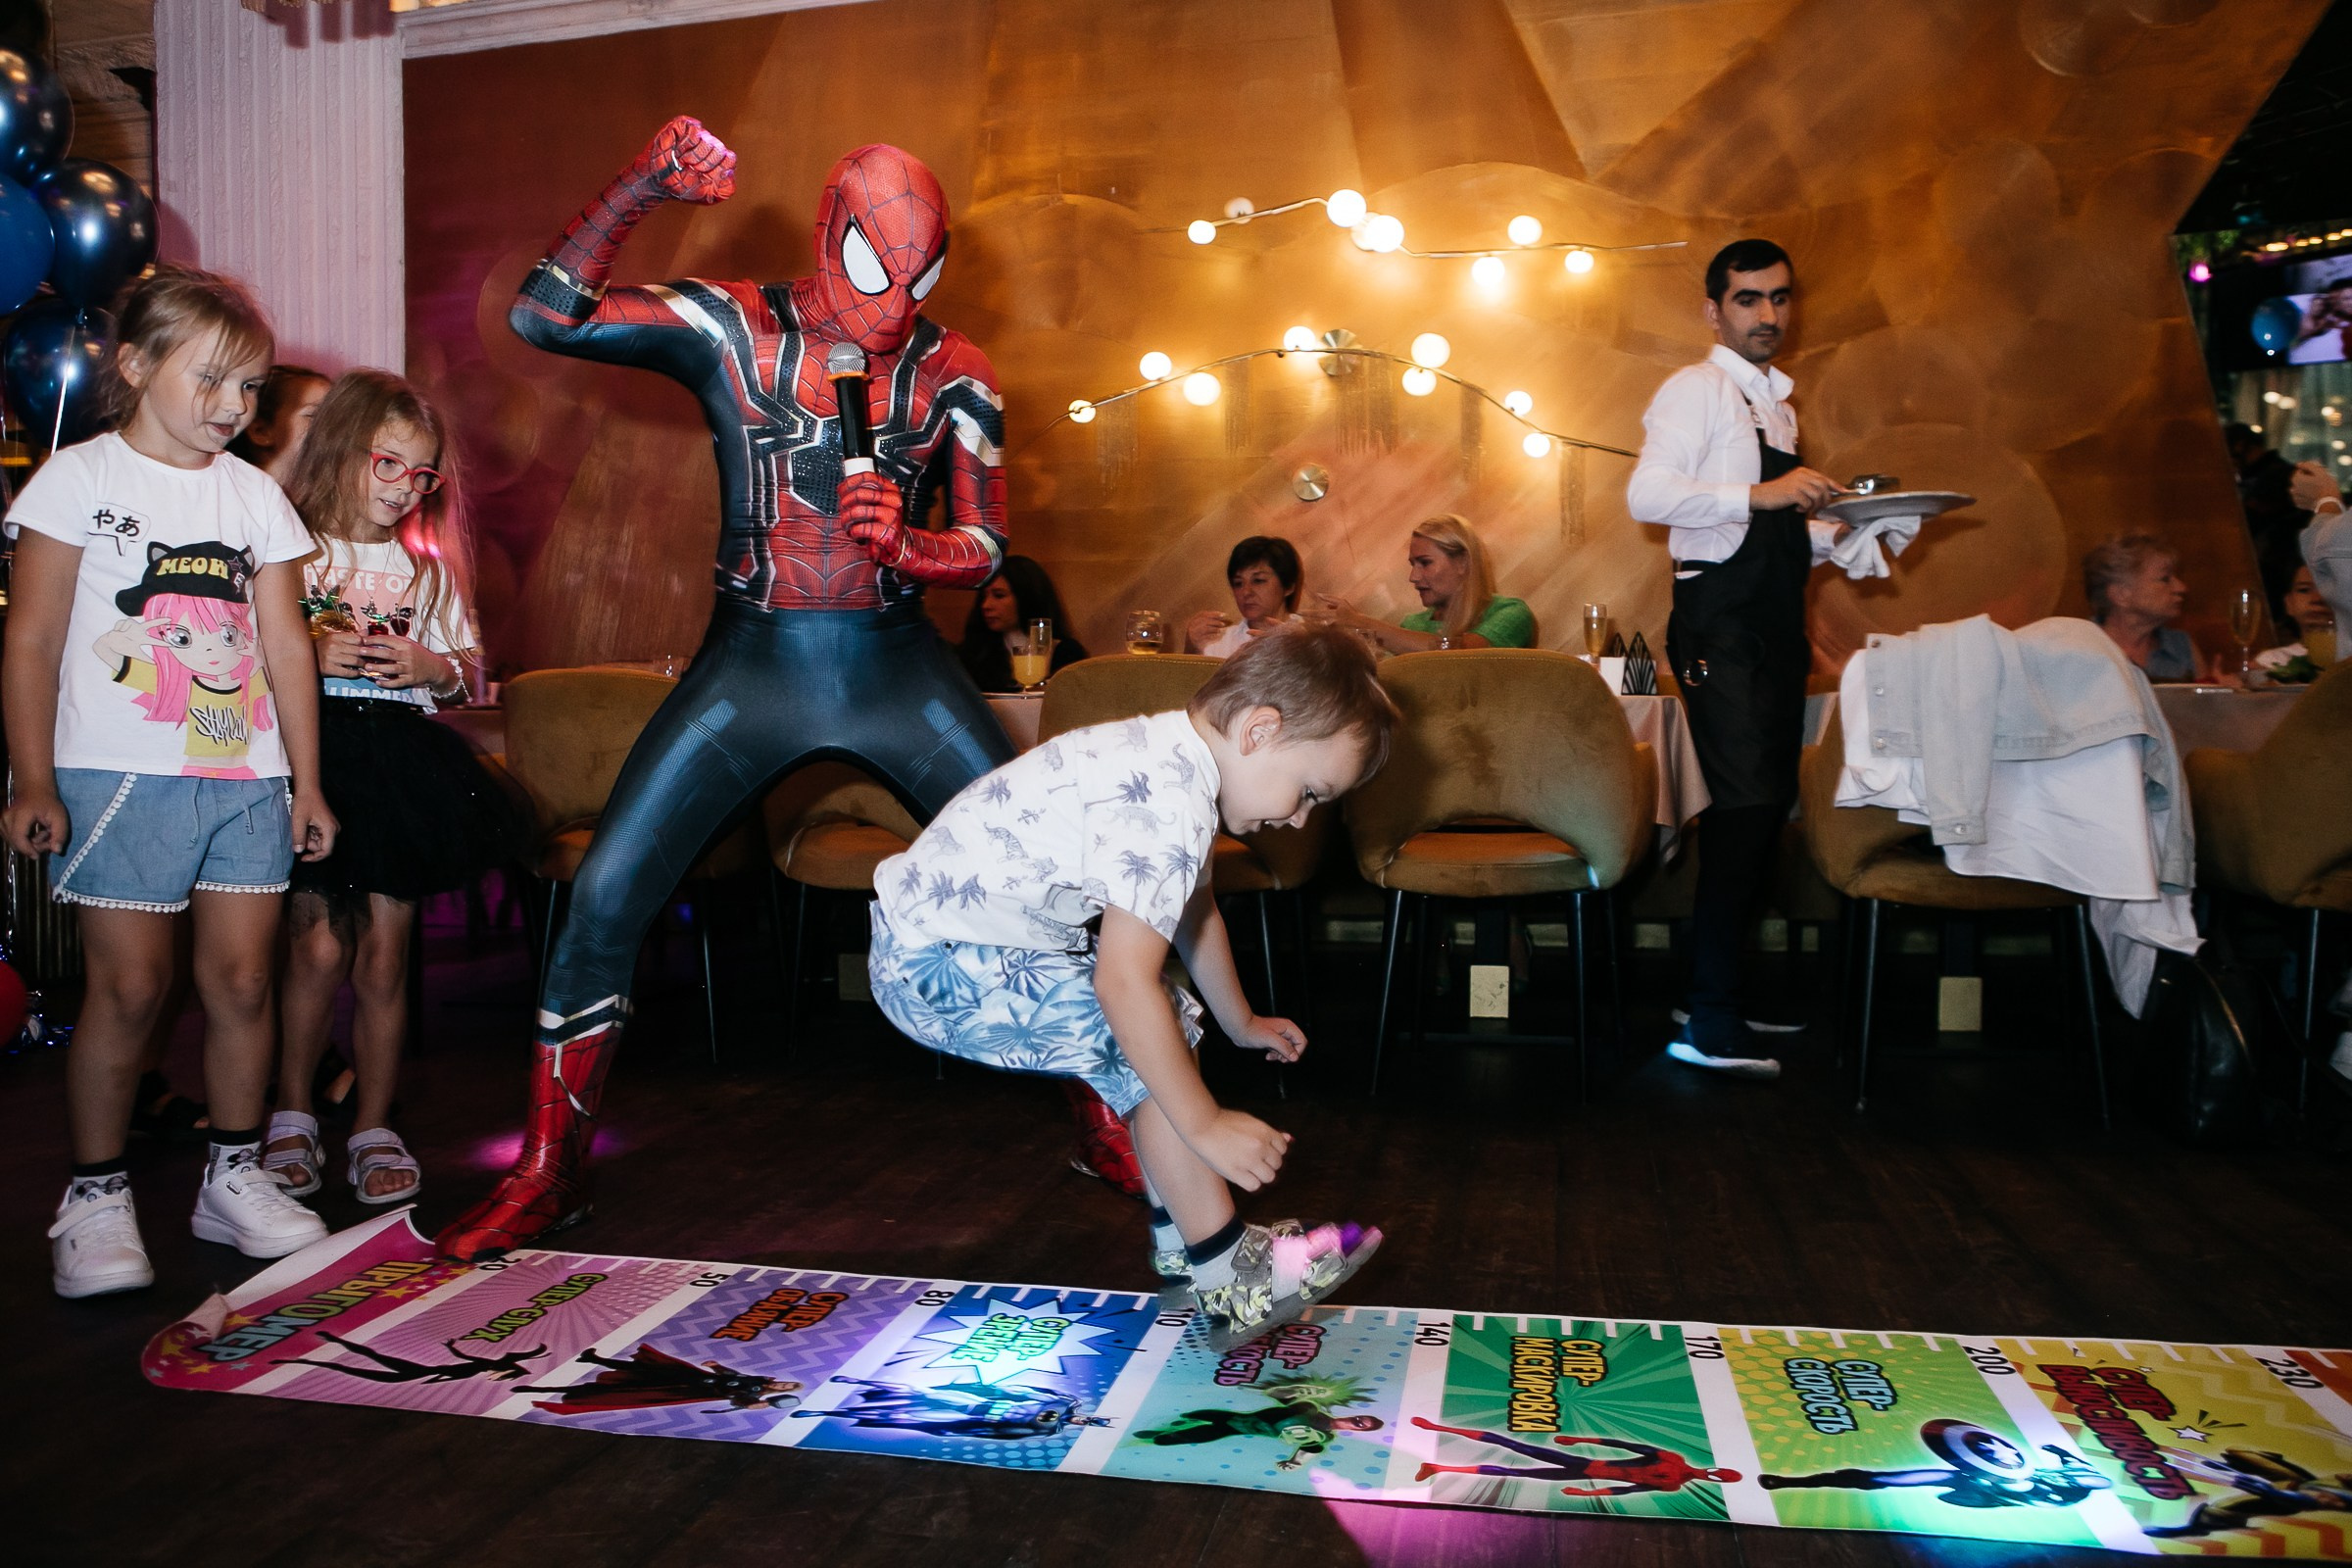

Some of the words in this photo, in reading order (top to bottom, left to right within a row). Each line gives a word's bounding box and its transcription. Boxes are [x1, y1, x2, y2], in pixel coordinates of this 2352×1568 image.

[93, 509, 141, 537] やあ
[689, 1272, 730, 1288] 50
[913, 1290, 956, 1307] 80
[192, 1260, 438, 1362] ПРЫГОМЕР
[458, 1272, 609, 1343] СУПЕР-СЛУХ
[709, 1288, 809, 1342] ОБАЯНИЕ
[781, 1292, 850, 1333] СУПЕР-
[1154, 1307, 1196, 1327] 110
[951, 1312, 1029, 1363] ЗРЕНИЕ
[1010, 1316, 1073, 1360] СУПЕР-
[1271, 1323, 1327, 1370] СУПЕР-
[1413, 1321, 1451, 1347] 140
[1684, 1335, 1726, 1360] 170
[1507, 1335, 1561, 1433] МАСКИРОВКА
[1558, 1338, 1609, 1387] СУПЕР-
[1961, 1345, 2017, 1376] 200
[2254, 1356, 2326, 1390] 230
[1783, 1356, 1859, 1436] СКОРОСТЬ
[1830, 1358, 1898, 1411] СУПЕР-
[2090, 1366, 2178, 1421] СУПЕР-
[2036, 1363, 2197, 1500] ВЫНОСЛИВОСТЬ
